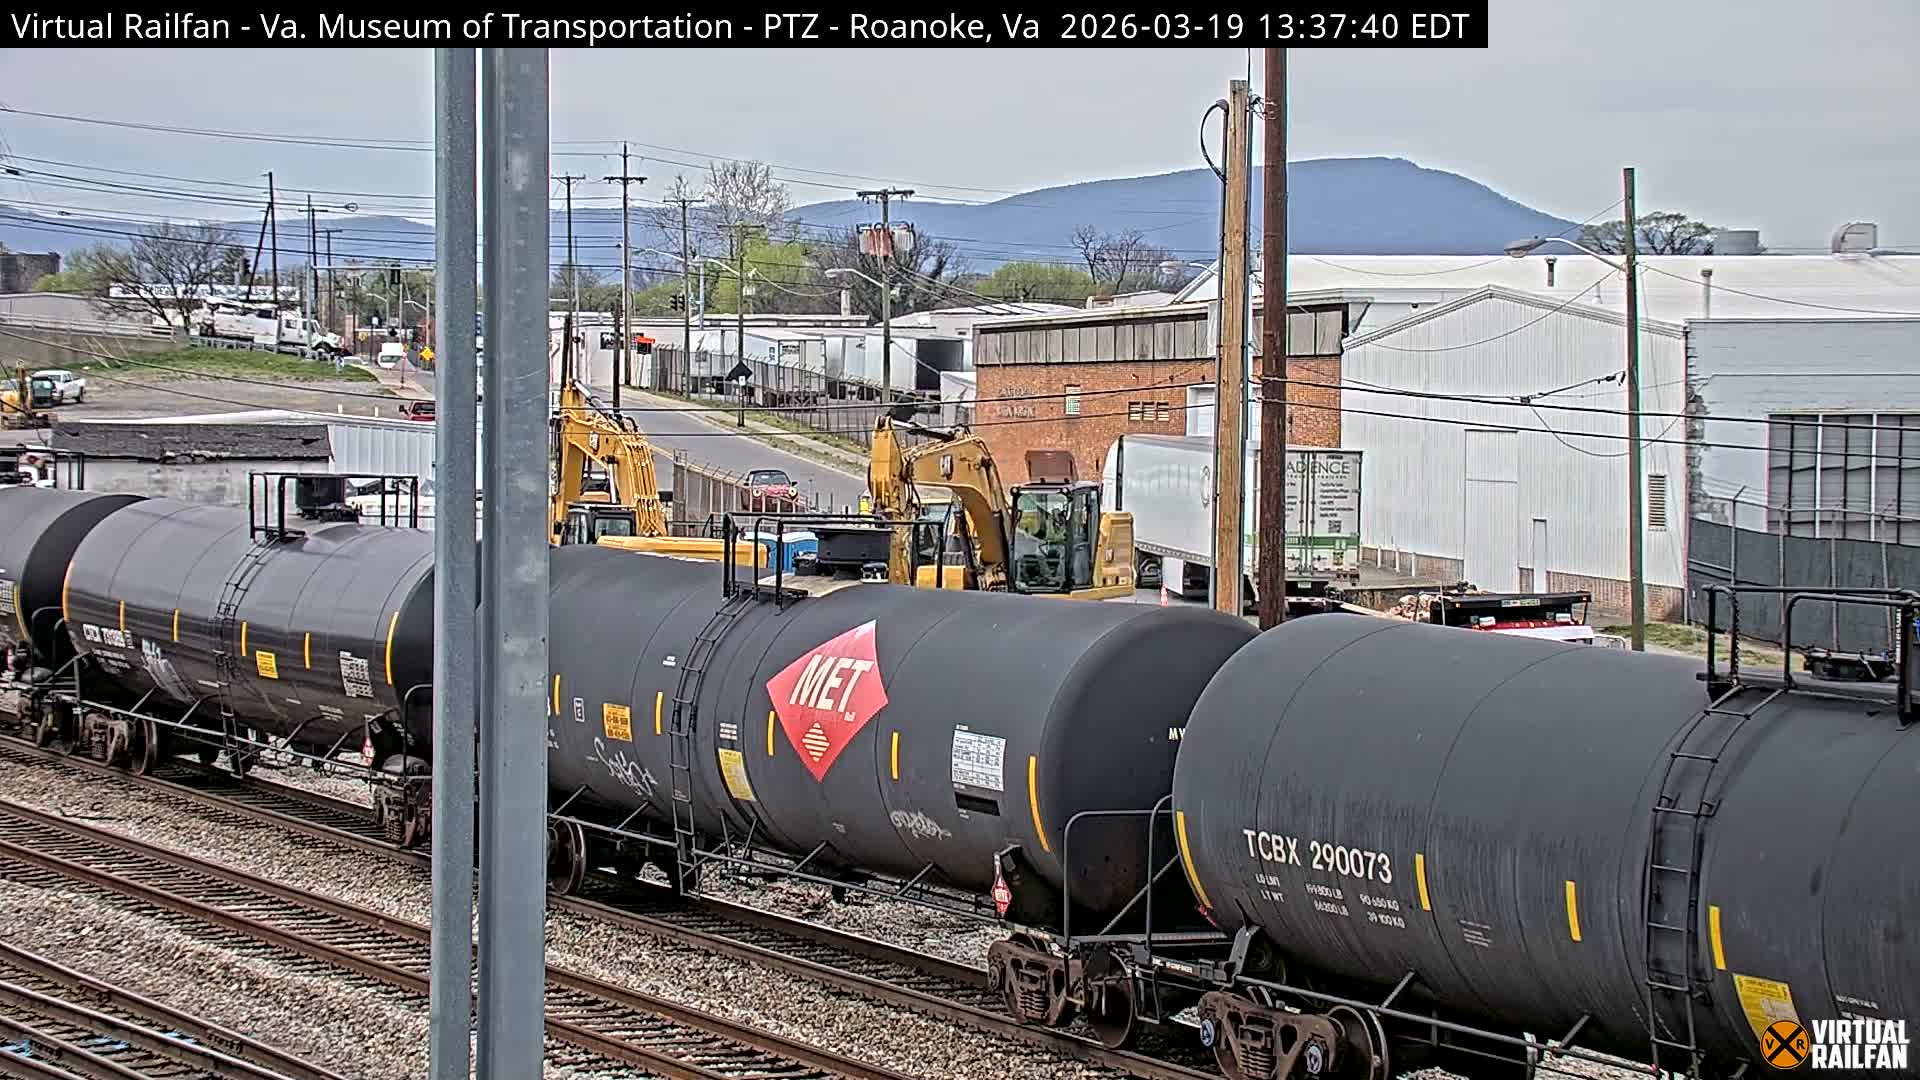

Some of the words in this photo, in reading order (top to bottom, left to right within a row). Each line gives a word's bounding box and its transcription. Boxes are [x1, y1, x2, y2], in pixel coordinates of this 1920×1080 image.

[789, 654, 875, 712] MET
[1243, 829, 1301, 866] TCBX
[1310, 840, 1392, 884] 290073
